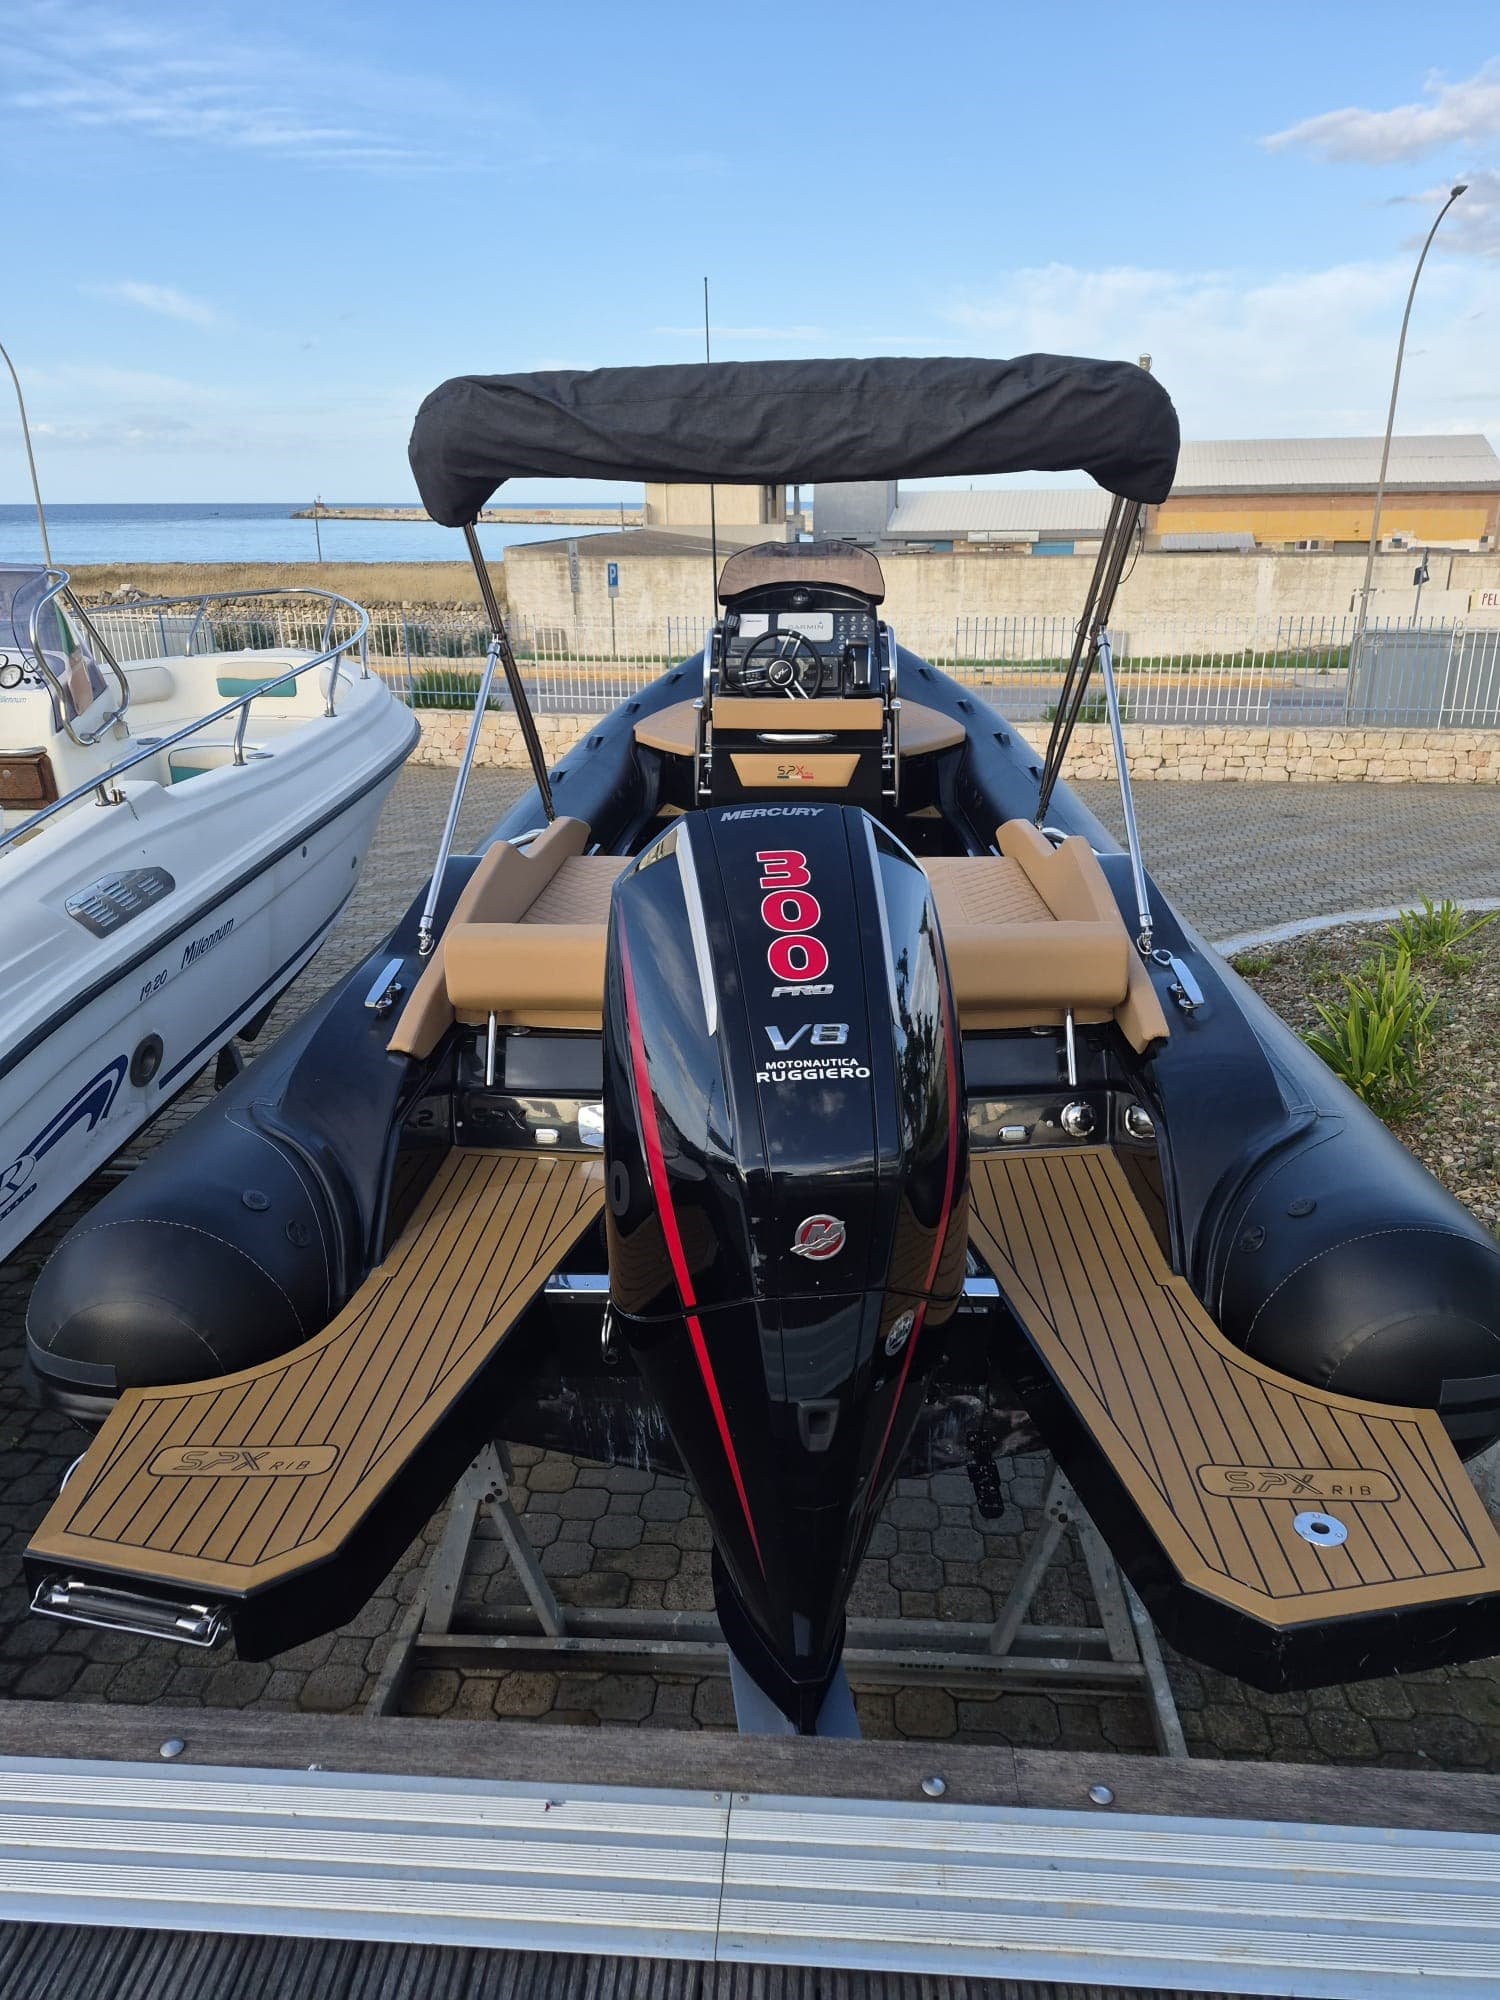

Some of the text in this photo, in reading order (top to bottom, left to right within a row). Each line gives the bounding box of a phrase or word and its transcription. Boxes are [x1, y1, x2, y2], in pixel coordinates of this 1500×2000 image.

[720, 807, 824, 822] MERCURY
[756, 850, 829, 982] 300
[140, 969, 168, 1002] 19.20
[771, 983, 834, 998] PRO
[764, 1023, 850, 1051] V8
[765, 1058, 859, 1069] MOTONAUTICA
[756, 1067, 871, 1083] RUGGIERO
[172, 1451, 311, 1471] SPX RIB
[1224, 1471, 1373, 1496] SPX RIB
